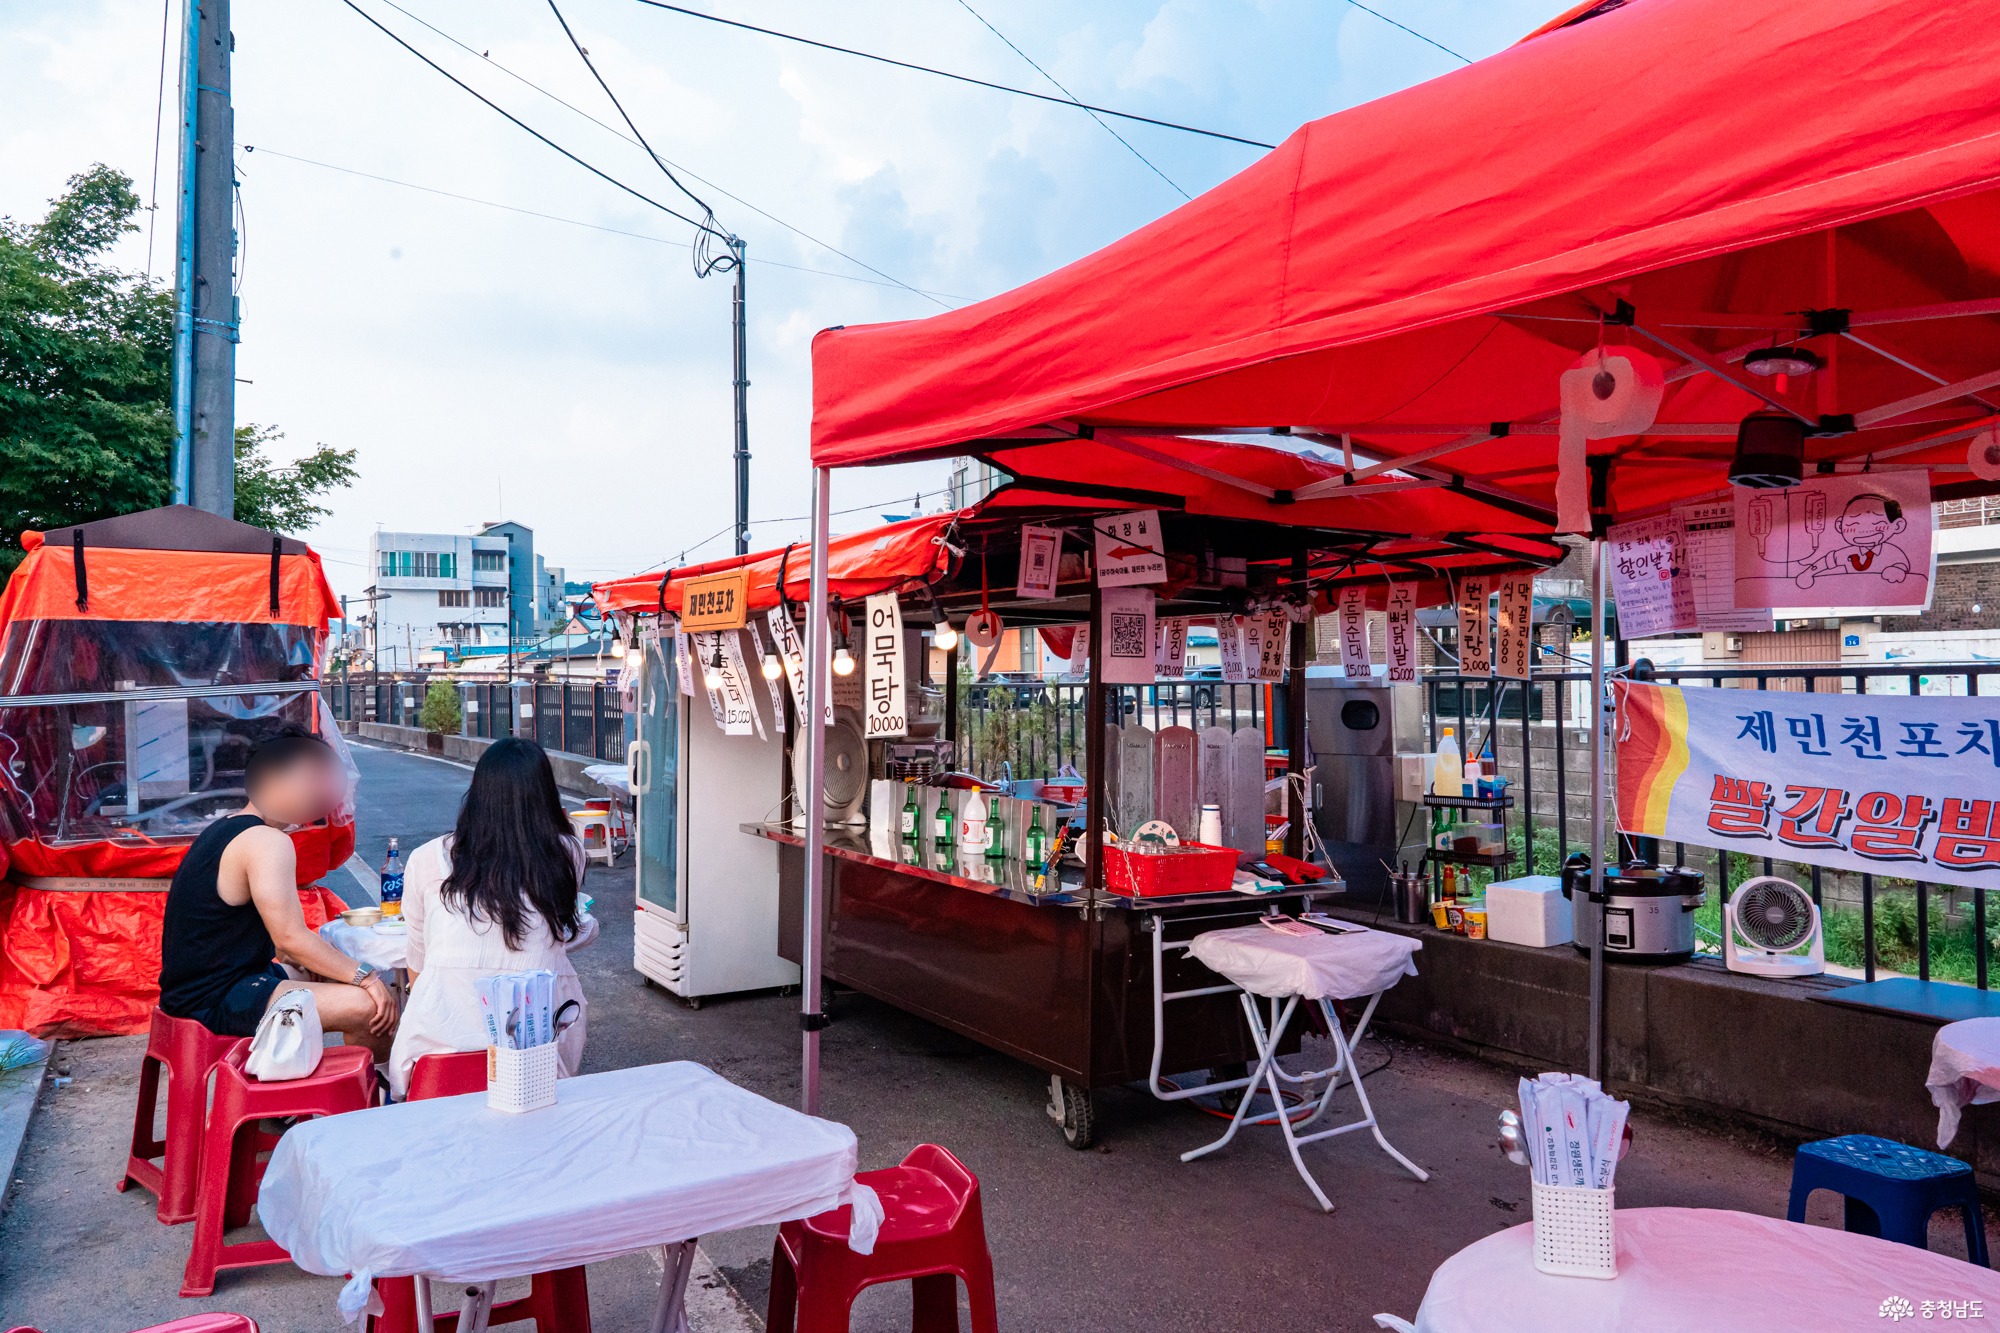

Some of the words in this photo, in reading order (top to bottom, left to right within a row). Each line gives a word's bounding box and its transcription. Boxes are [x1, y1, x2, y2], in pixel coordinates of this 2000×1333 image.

[1107, 520, 1147, 537] 화장실
[1616, 547, 1687, 580] 할인받자!
[689, 588, 735, 617] 제민천포차
[1343, 589, 1363, 660] 모듬순대
[1464, 583, 1483, 657] 번데기탕
[1518, 583, 1530, 639] 막걸리
[1389, 589, 1412, 667] 무뼈닭발
[871, 605, 900, 715] 어묵탕
[1462, 658, 1490, 672] 5,000
[1648, 906, 1659, 914] 35
[1569, 1140, 1585, 1188] 장원생돈까
